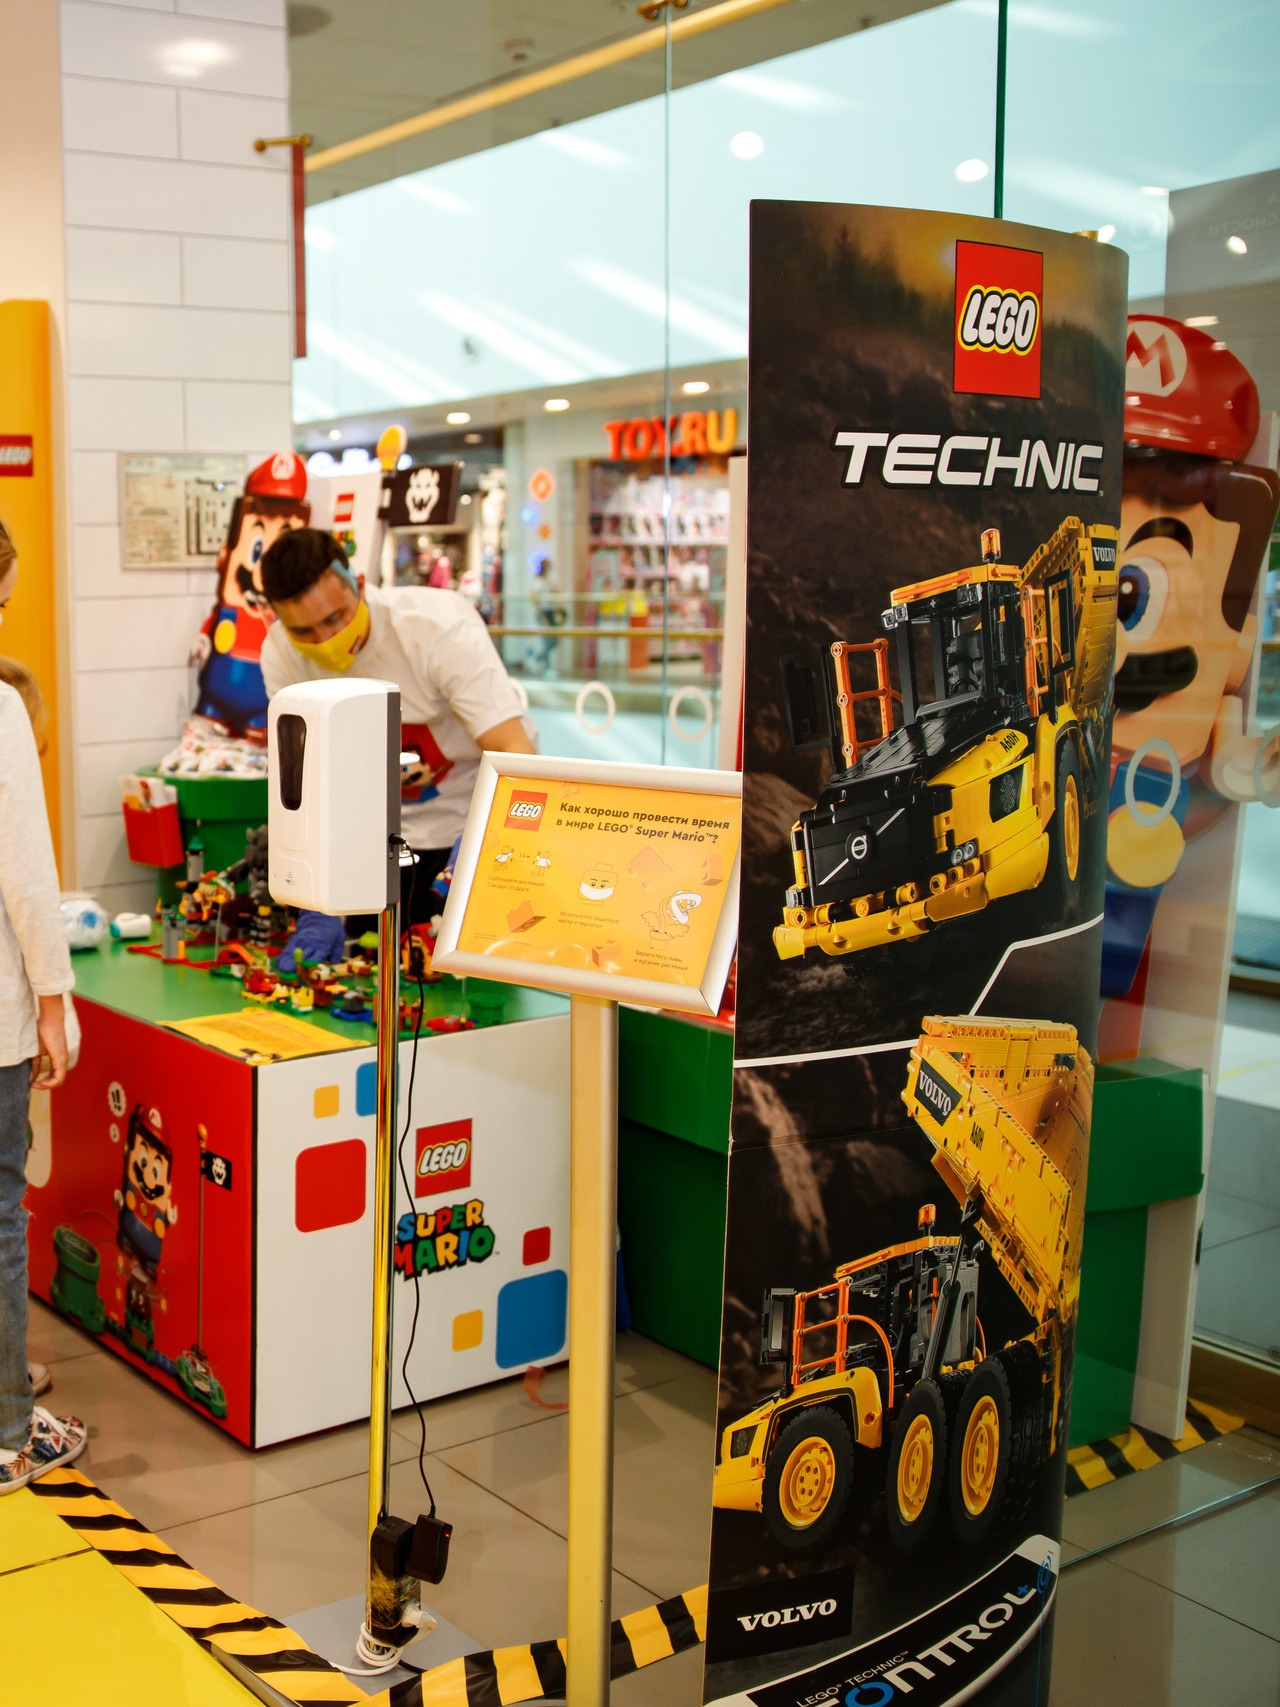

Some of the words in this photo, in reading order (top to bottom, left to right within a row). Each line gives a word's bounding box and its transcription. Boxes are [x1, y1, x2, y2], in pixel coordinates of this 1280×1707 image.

[961, 290, 1037, 350] LEGO
[603, 408, 737, 461] TOY.RU
[835, 432, 1103, 492] TECHNIC
[1092, 546, 1116, 562] VOLVO
[1000, 731, 1020, 753] A60H
[509, 801, 543, 819] LEGO
[560, 802, 581, 813] Как
[584, 806, 629, 818] хорошо
[632, 812, 689, 825] провести
[692, 818, 730, 829] время
[556, 818, 563, 826] в
[566, 820, 595, 831] мире
[635, 826, 669, 839] Super
[919, 1069, 952, 1117] VOLVO
[420, 1141, 469, 1175] LEGO
[397, 1199, 483, 1241] SUPER
[394, 1225, 495, 1281] MARIO
[737, 1598, 837, 1632] VOLVO
